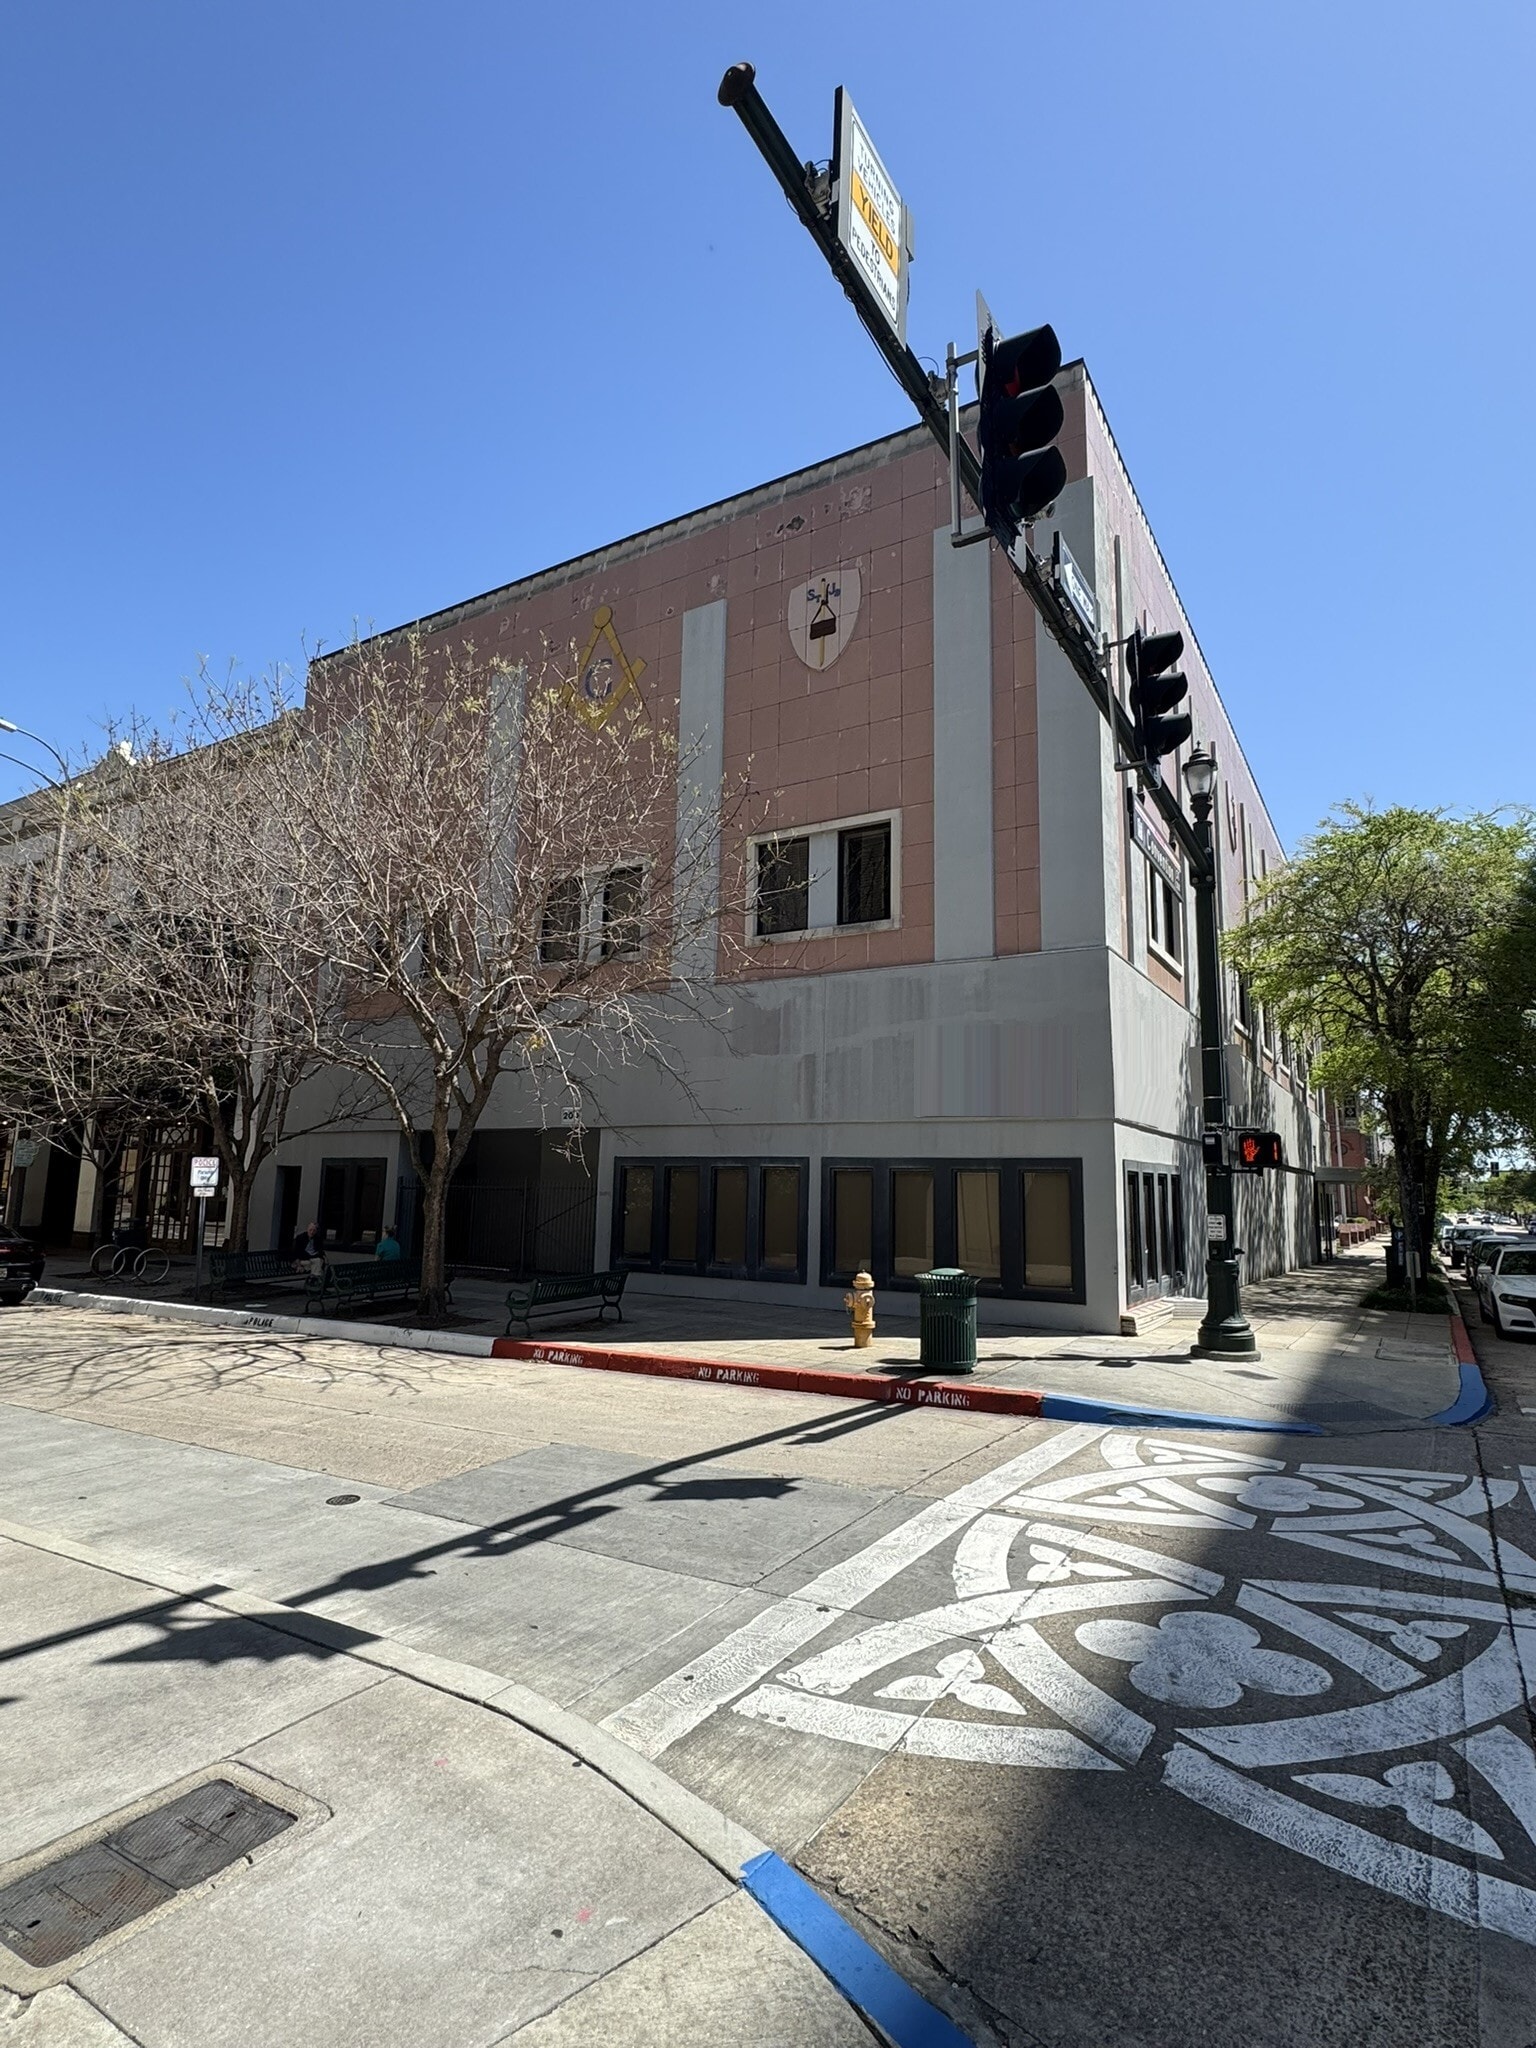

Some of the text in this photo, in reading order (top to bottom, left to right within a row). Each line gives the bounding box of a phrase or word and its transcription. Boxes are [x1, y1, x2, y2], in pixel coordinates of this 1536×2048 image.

[857, 156, 896, 236] VEHICLES
[859, 143, 895, 216] TURNING
[859, 184, 894, 260] YIELD
[851, 225, 896, 311] PEDESTRIANS
[870, 240, 881, 266] TO
[1146, 828, 1174, 883] Convention
[533, 1349, 584, 1365] NO PARKING
[698, 1366, 759, 1383] NO PARKING
[896, 1387, 970, 1407] NO PARKING
